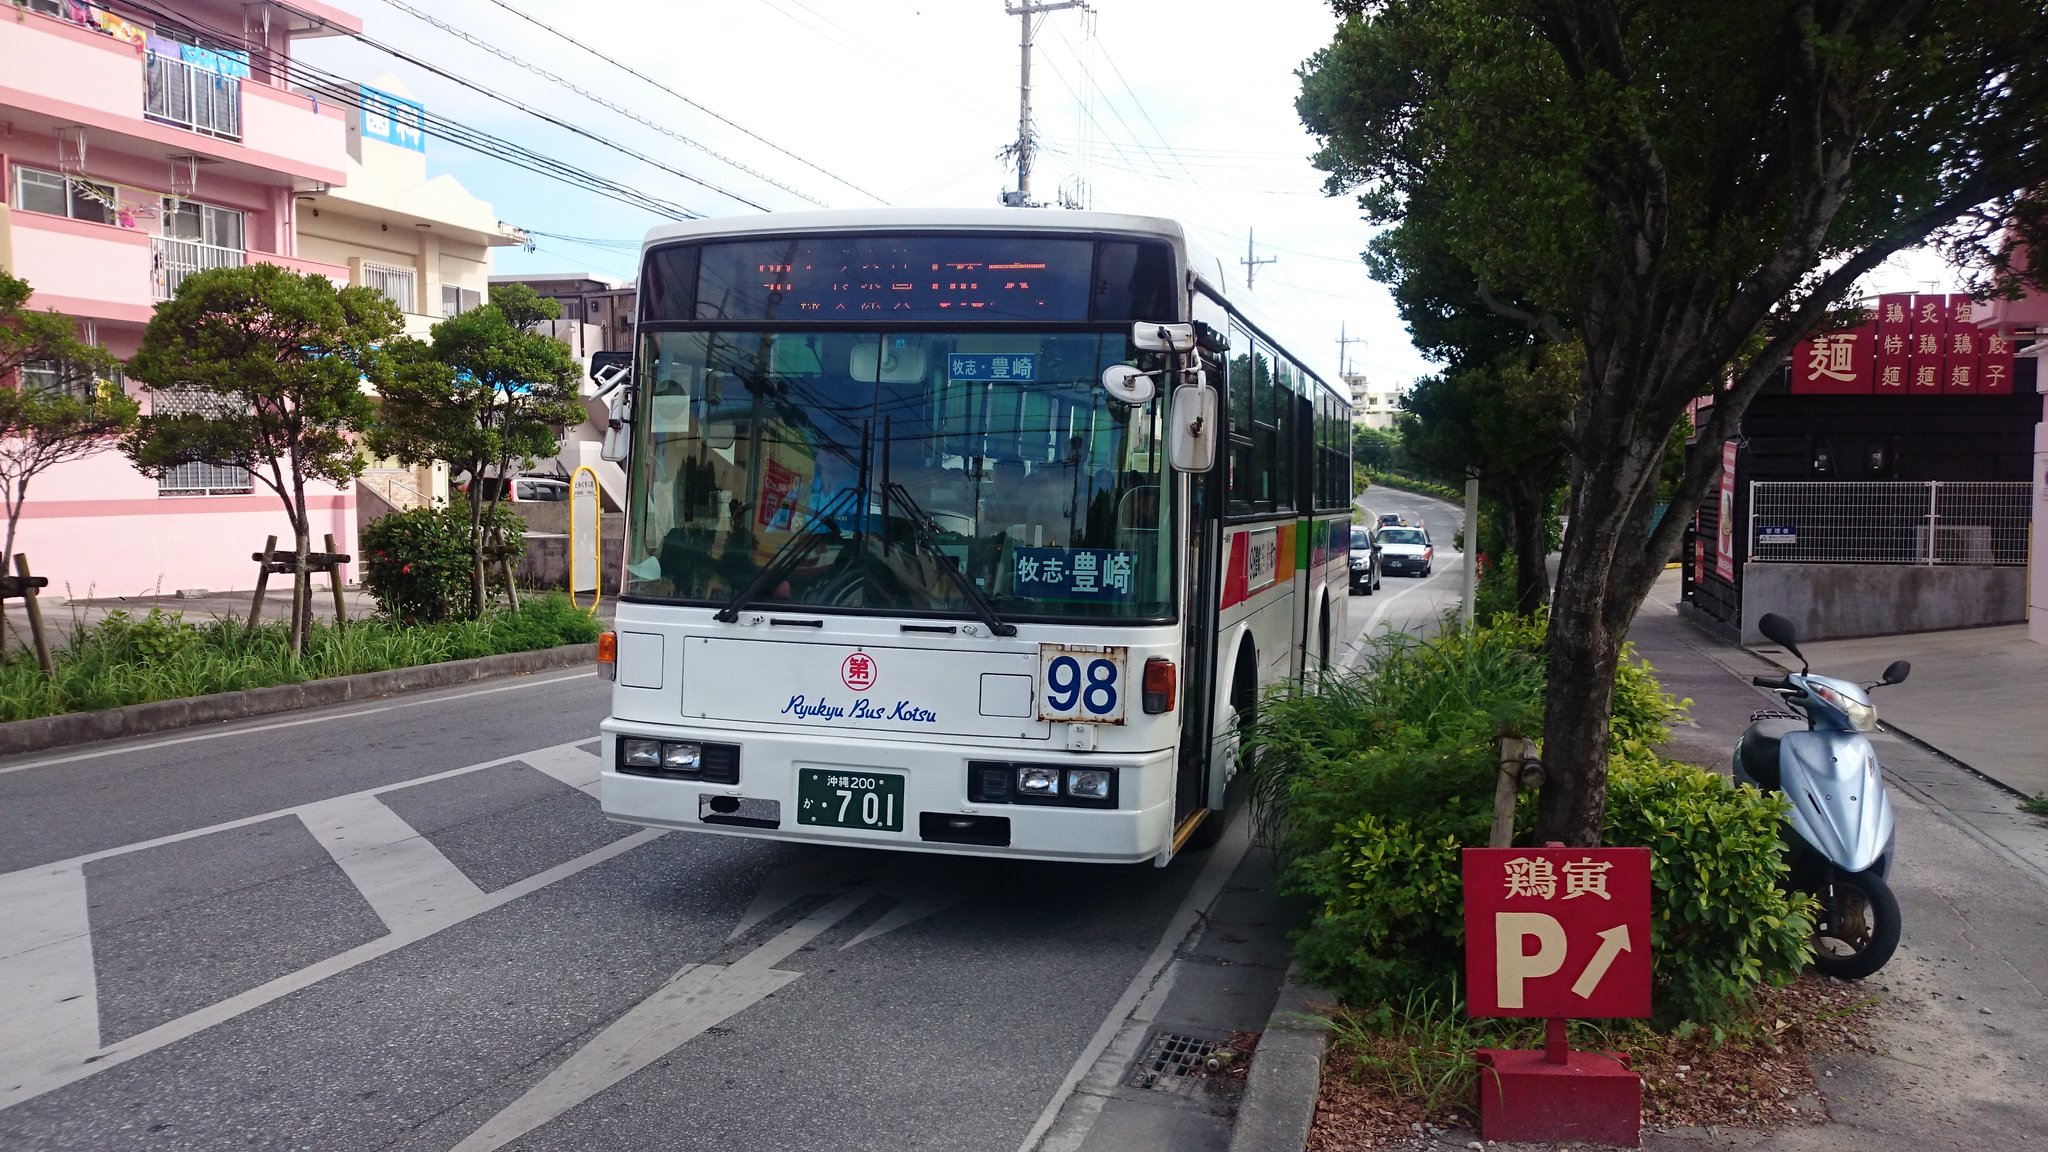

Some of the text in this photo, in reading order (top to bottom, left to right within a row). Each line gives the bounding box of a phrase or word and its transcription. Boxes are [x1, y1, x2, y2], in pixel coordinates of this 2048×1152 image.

[365, 95, 421, 145] 歯科
[952, 357, 1033, 379] 牧志・豊崎
[1808, 333, 1858, 382] 麺
[1882, 303, 1904, 387] 鶏特麺
[1915, 303, 1937, 387] 炙鶏麺
[1951, 303, 1972, 387] 塩鶏麺
[1018, 551, 1131, 594] 牧志・豊崎
[781, 694, 937, 723] Ryukyu Bus Kotsu
[1047, 656, 1118, 715] 98
[803, 797, 814, 809] か
[1503, 856, 1614, 901] 鶏寅
[1496, 911, 1568, 1009] P
